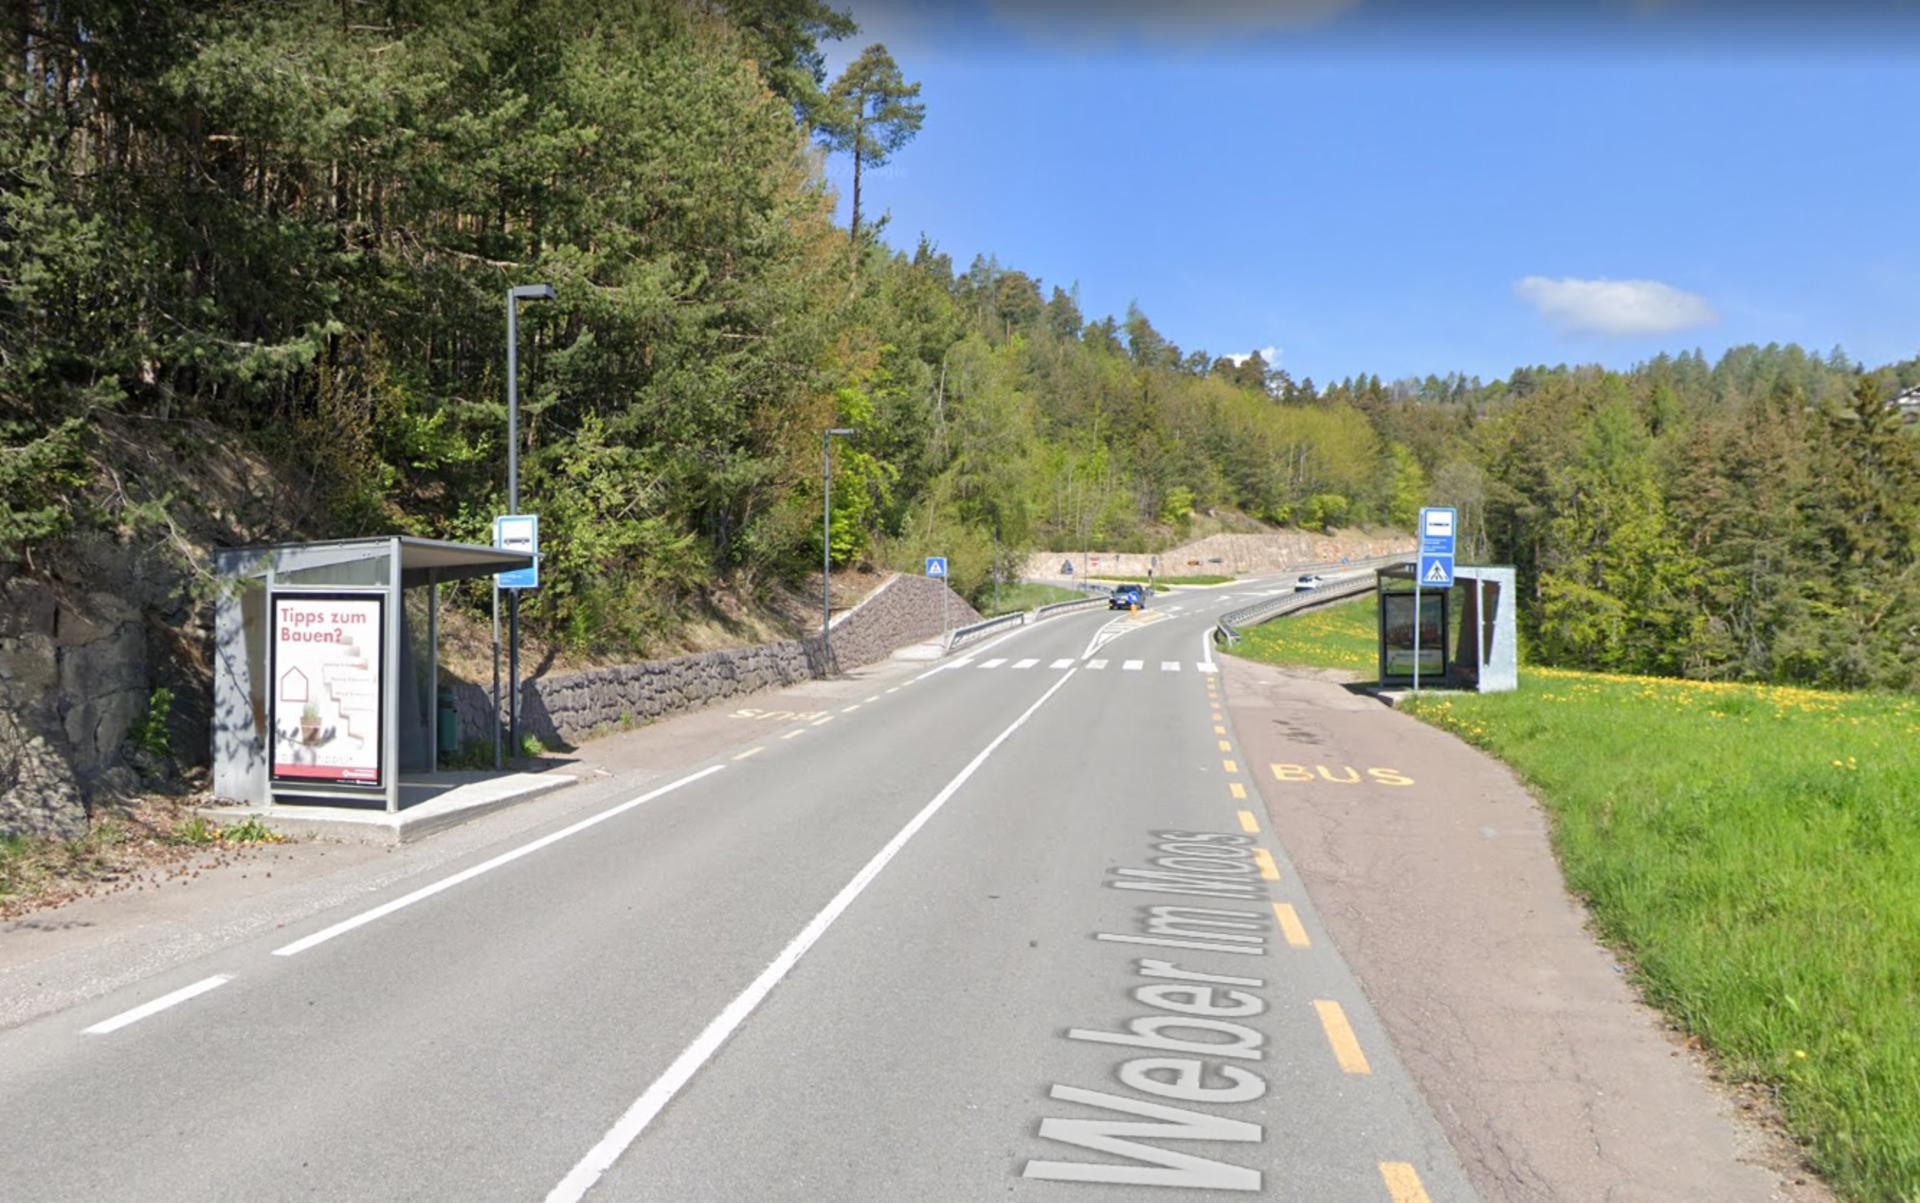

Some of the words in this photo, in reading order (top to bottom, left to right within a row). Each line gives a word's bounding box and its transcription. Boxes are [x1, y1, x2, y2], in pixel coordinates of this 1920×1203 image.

[281, 607, 324, 627] Tipps
[331, 612, 367, 624] zum
[281, 626, 342, 643] Bauen?
[1270, 763, 1415, 785] BUS
